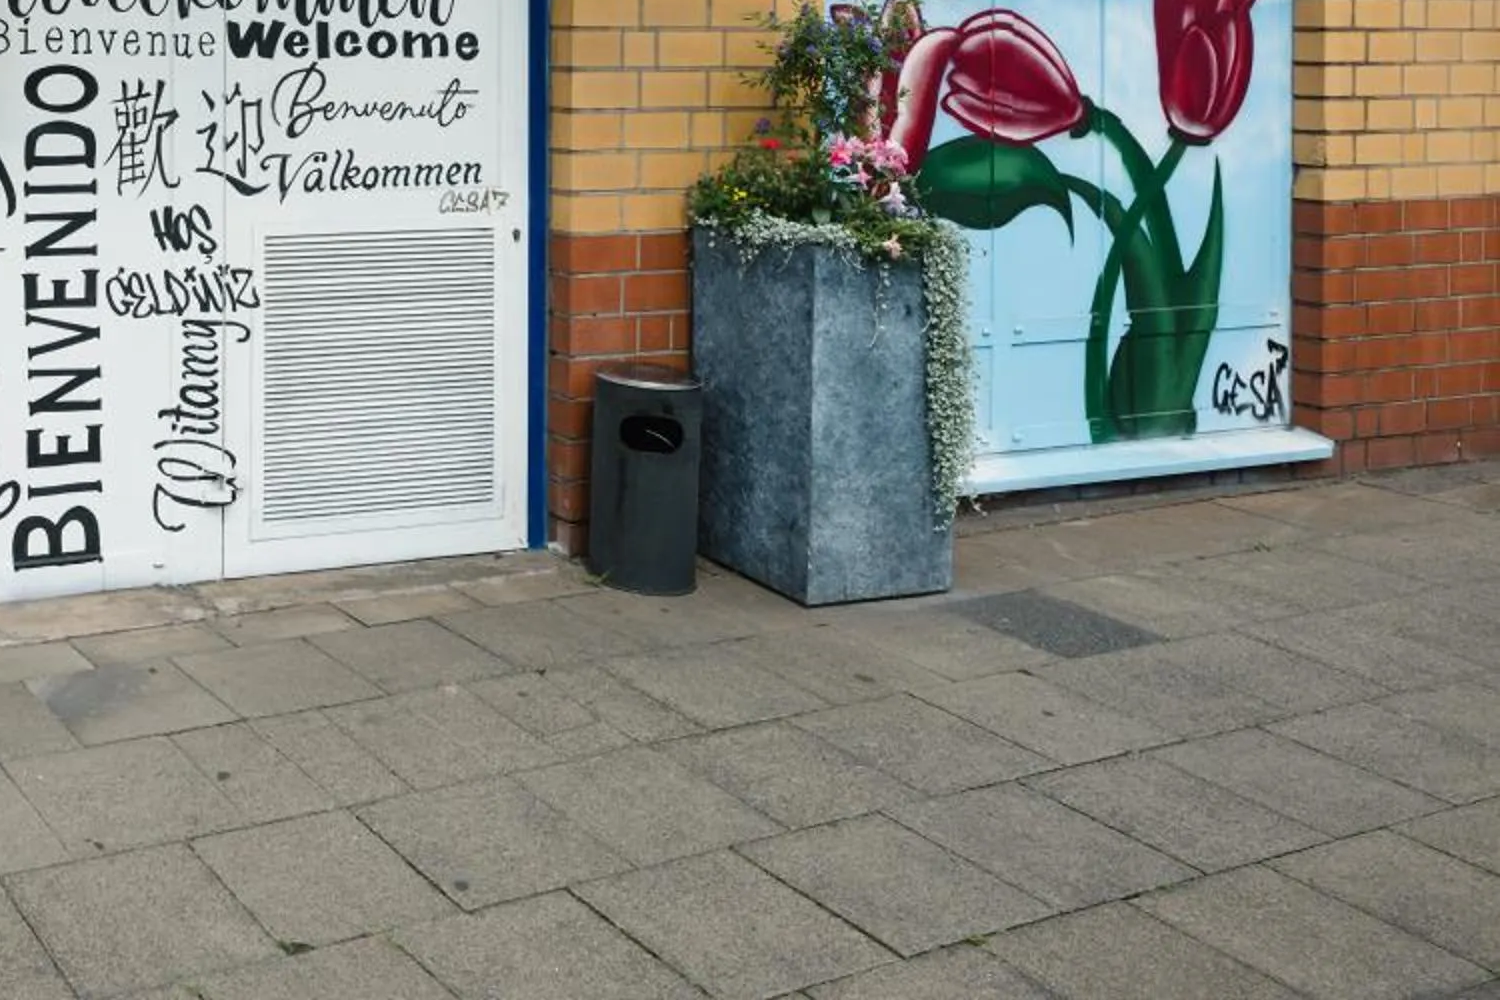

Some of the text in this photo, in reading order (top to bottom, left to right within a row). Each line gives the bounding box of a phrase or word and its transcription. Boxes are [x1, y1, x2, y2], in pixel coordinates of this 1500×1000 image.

[227, 19, 480, 61] Welcome
[271, 61, 480, 139] Benvenuto
[260, 149, 483, 206] Välkommen
[12, 64, 103, 572] BIENVENIDO
[153, 318, 251, 532] Witamy
